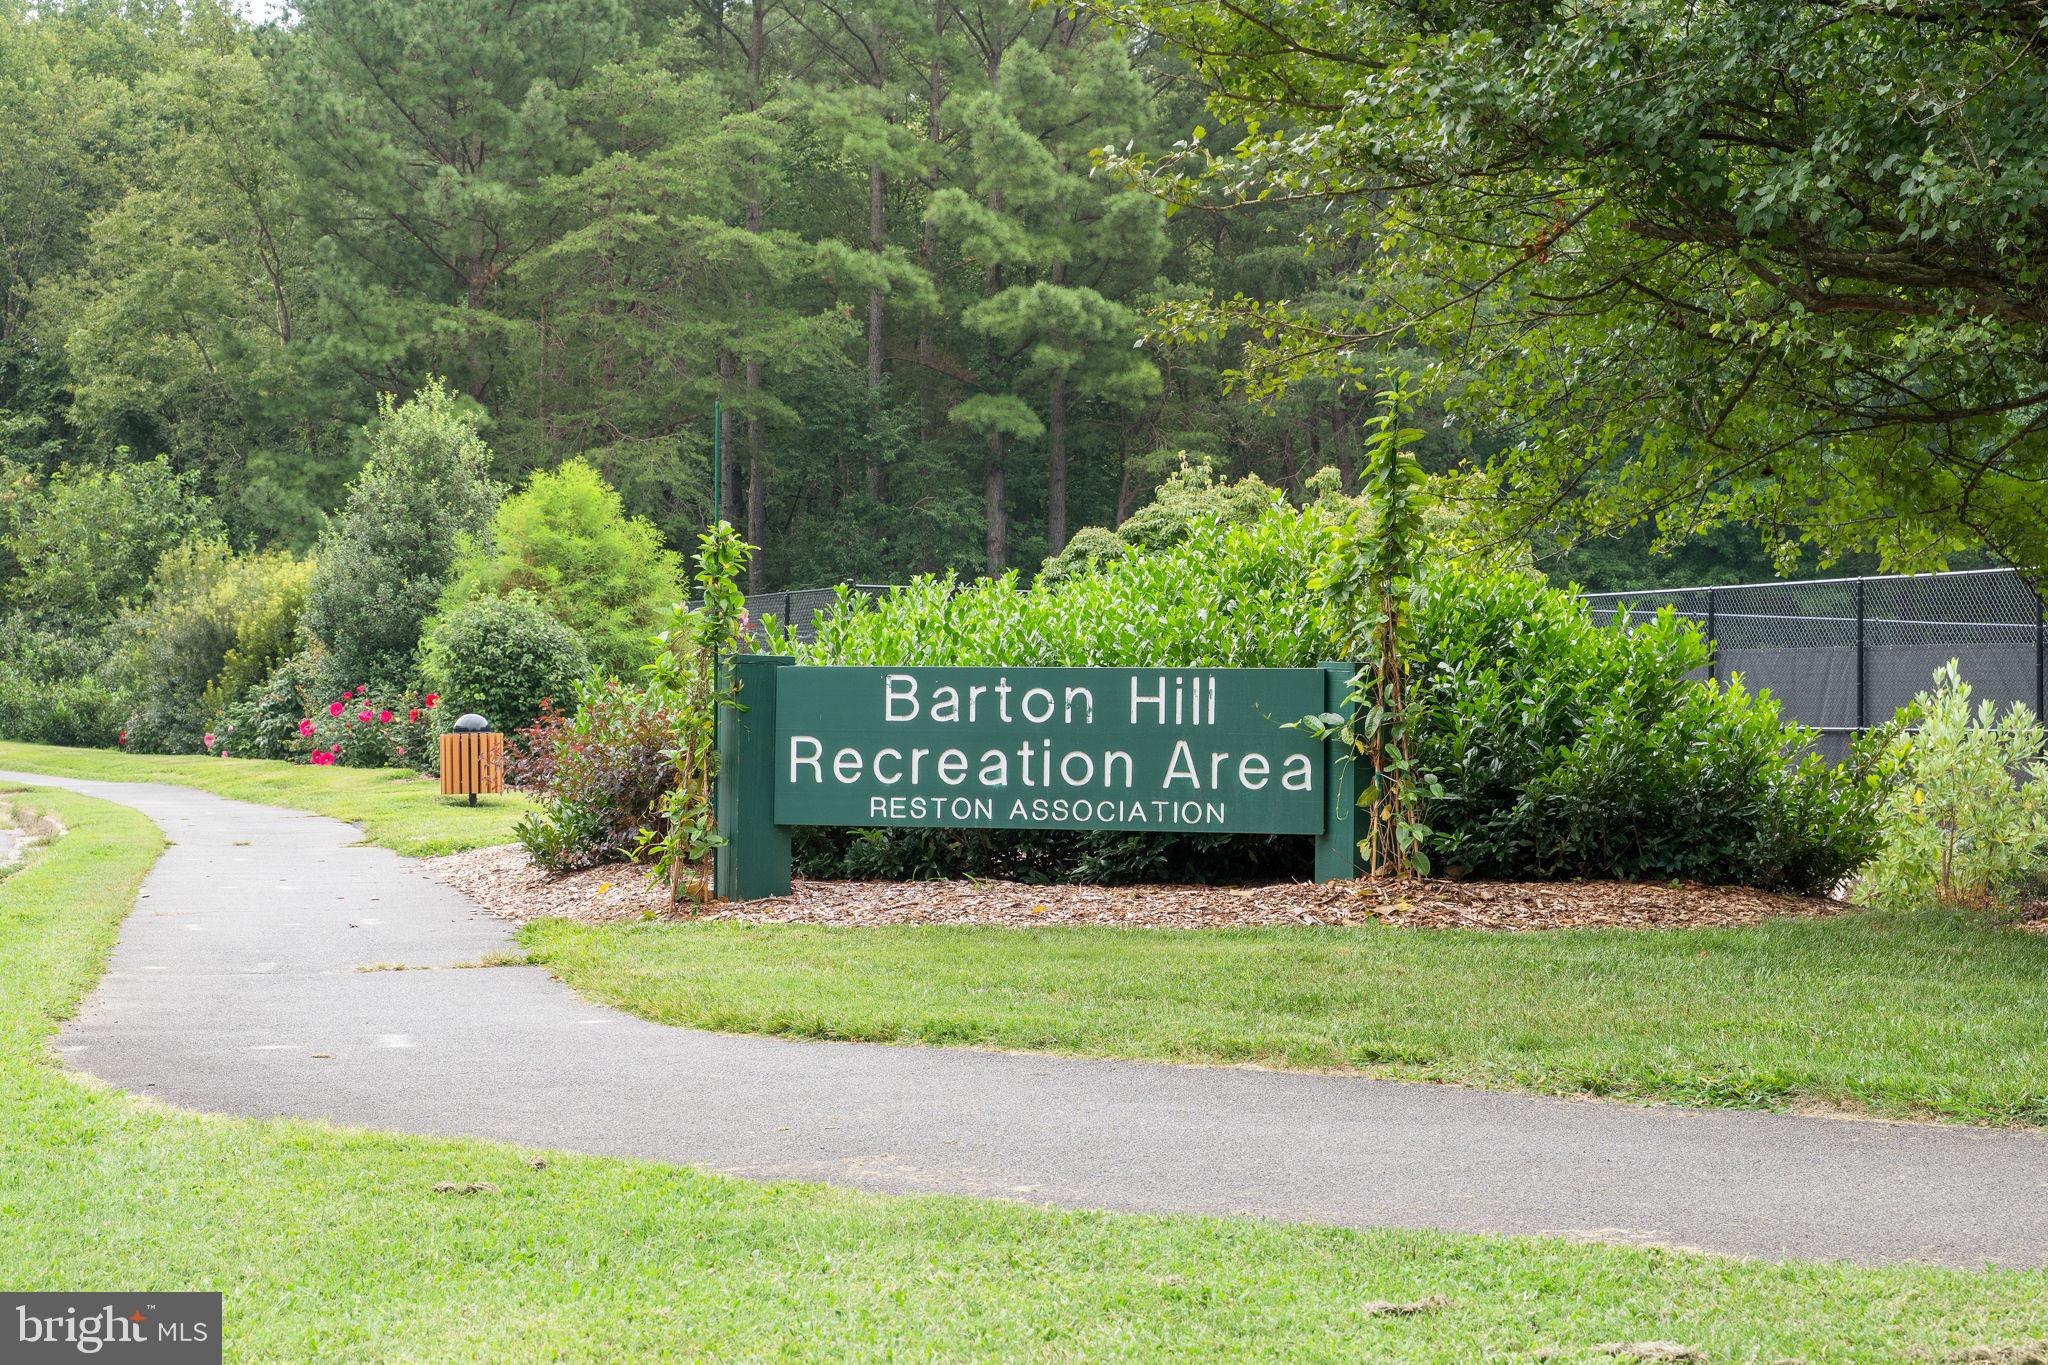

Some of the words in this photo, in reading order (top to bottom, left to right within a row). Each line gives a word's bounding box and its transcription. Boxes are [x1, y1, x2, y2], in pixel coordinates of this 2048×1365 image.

[884, 673, 1094, 725] Barton
[1130, 675, 1217, 726] Hill
[789, 735, 1133, 788] Recreation
[1161, 739, 1312, 791] Area
[869, 796, 993, 821] RESTON
[1007, 798, 1226, 825] ASSOCIATION
